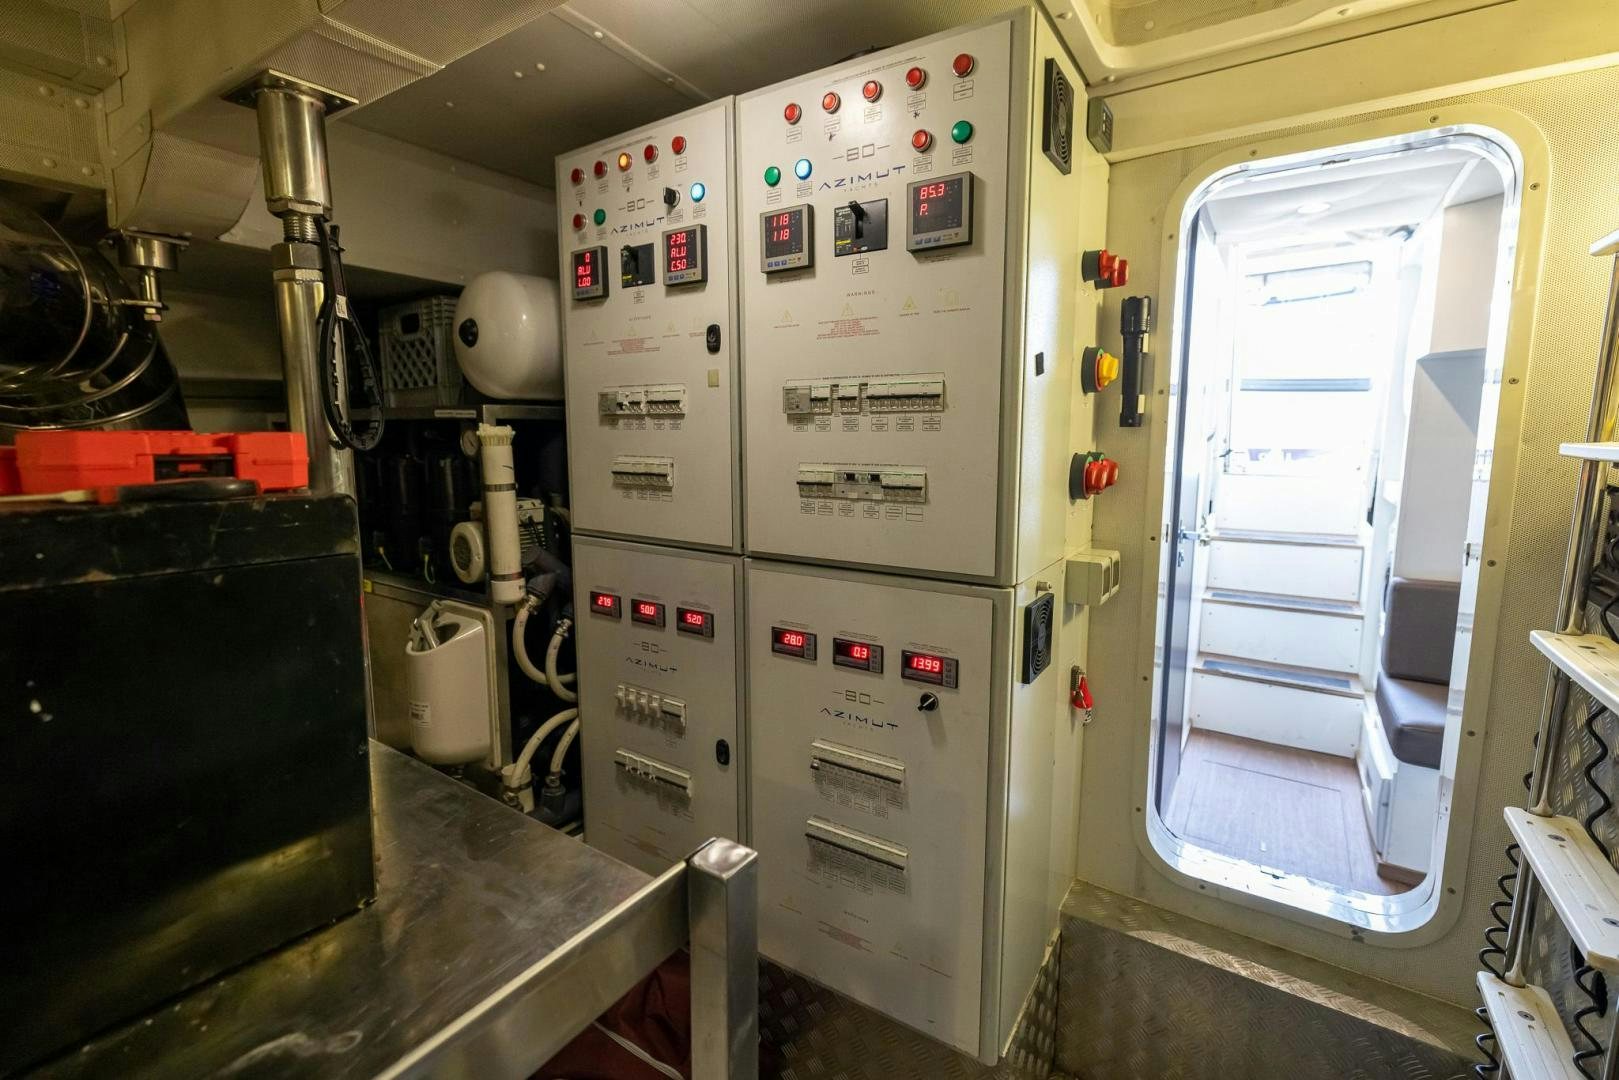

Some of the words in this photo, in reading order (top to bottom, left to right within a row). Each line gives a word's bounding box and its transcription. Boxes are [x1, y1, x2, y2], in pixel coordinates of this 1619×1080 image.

[819, 165, 906, 191] AZIMUT
[611, 216, 665, 234] AZIMUT
[625, 656, 678, 673] AZIMUT
[820, 707, 899, 731] AZIMUT
